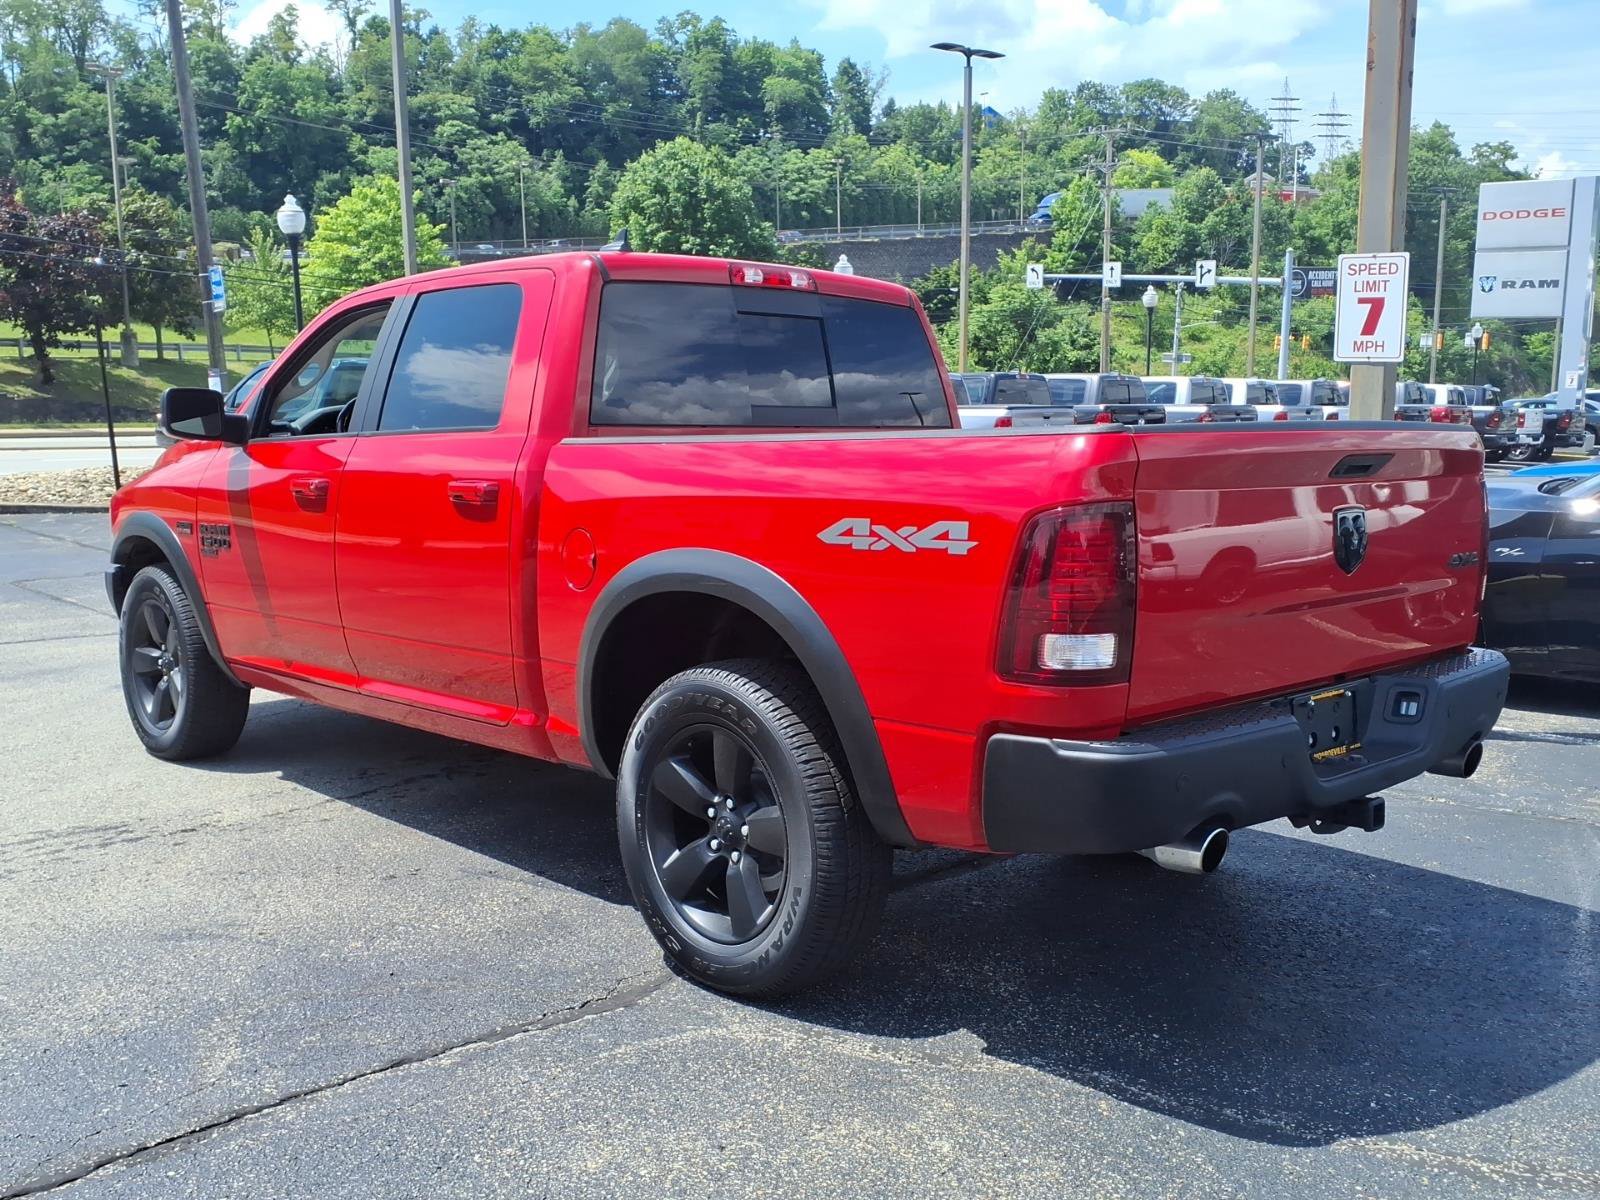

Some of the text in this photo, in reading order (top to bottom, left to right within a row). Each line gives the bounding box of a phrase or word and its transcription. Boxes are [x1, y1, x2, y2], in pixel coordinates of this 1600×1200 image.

[1482, 207, 1566, 221] DODGE
[1347, 262, 1399, 276] SPEED
[1353, 280, 1390, 293] LIMIT
[1501, 279, 1560, 289] RAM
[1357, 297, 1386, 336] 7
[1352, 340, 1385, 353] MPH
[634, 692, 759, 752] GOODYEAR
